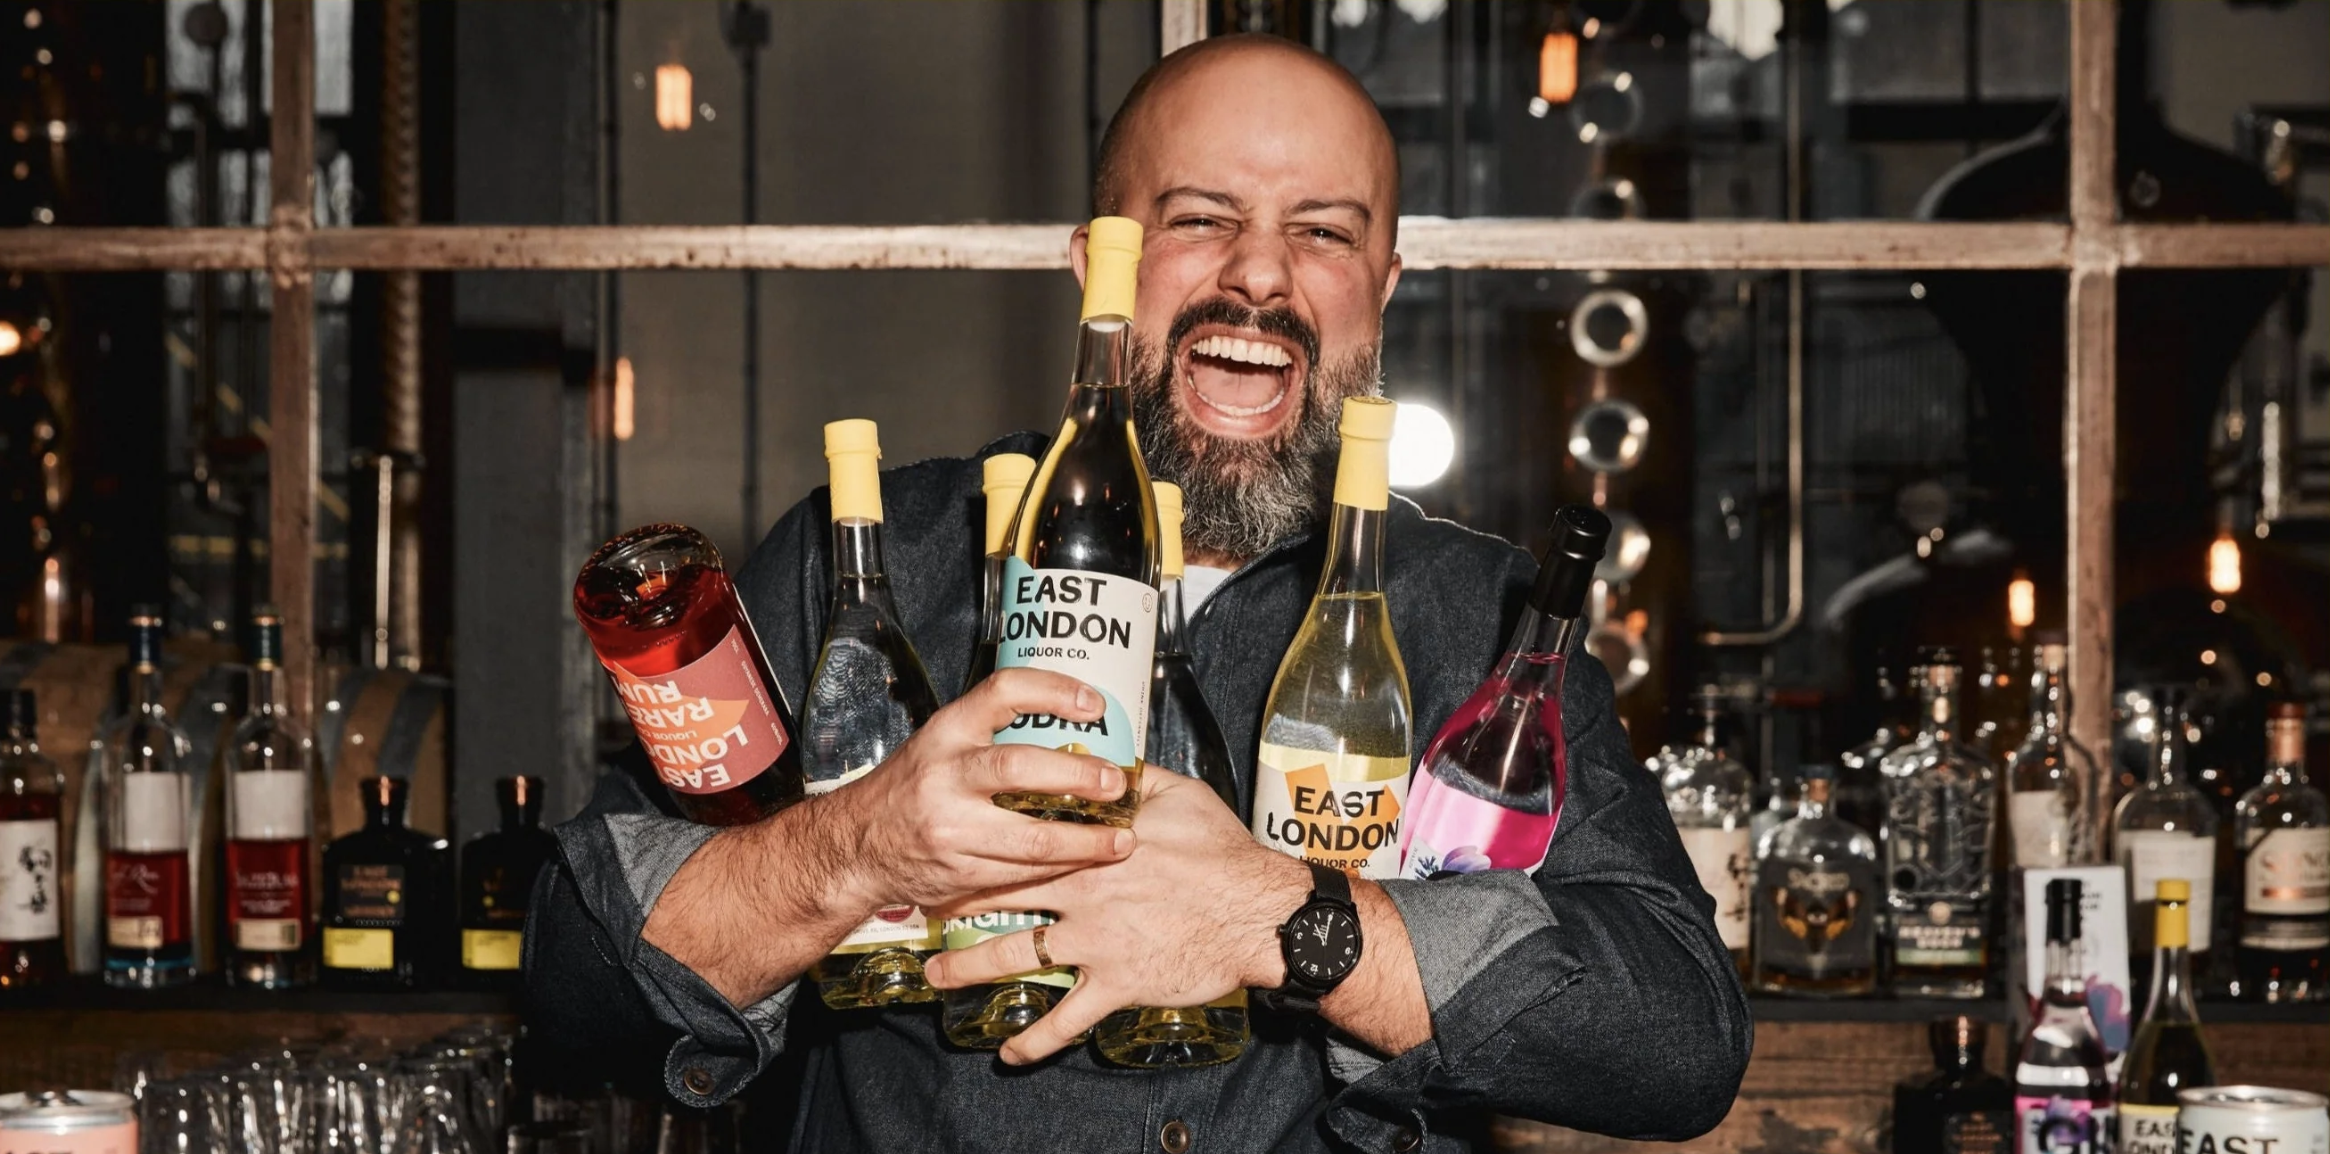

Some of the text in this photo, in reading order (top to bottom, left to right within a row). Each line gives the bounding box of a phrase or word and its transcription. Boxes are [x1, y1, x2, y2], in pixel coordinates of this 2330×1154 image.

[1016, 575, 1107, 606] EAST
[999, 611, 1131, 649] LONDON
[1018, 647, 1090, 660] LIQUOR CO.
[611, 675, 683, 704] RUM
[626, 696, 715, 729] RARE
[641, 724, 749, 765] LOND
[652, 729, 698, 741] LIQUOR
[655, 762, 731, 789] EAS
[1294, 785, 1385, 818] EAST
[1266, 811, 1399, 851] LONDON
[1351, 858, 1371, 869] CO.
[2133, 1119, 2176, 1138] EAS
